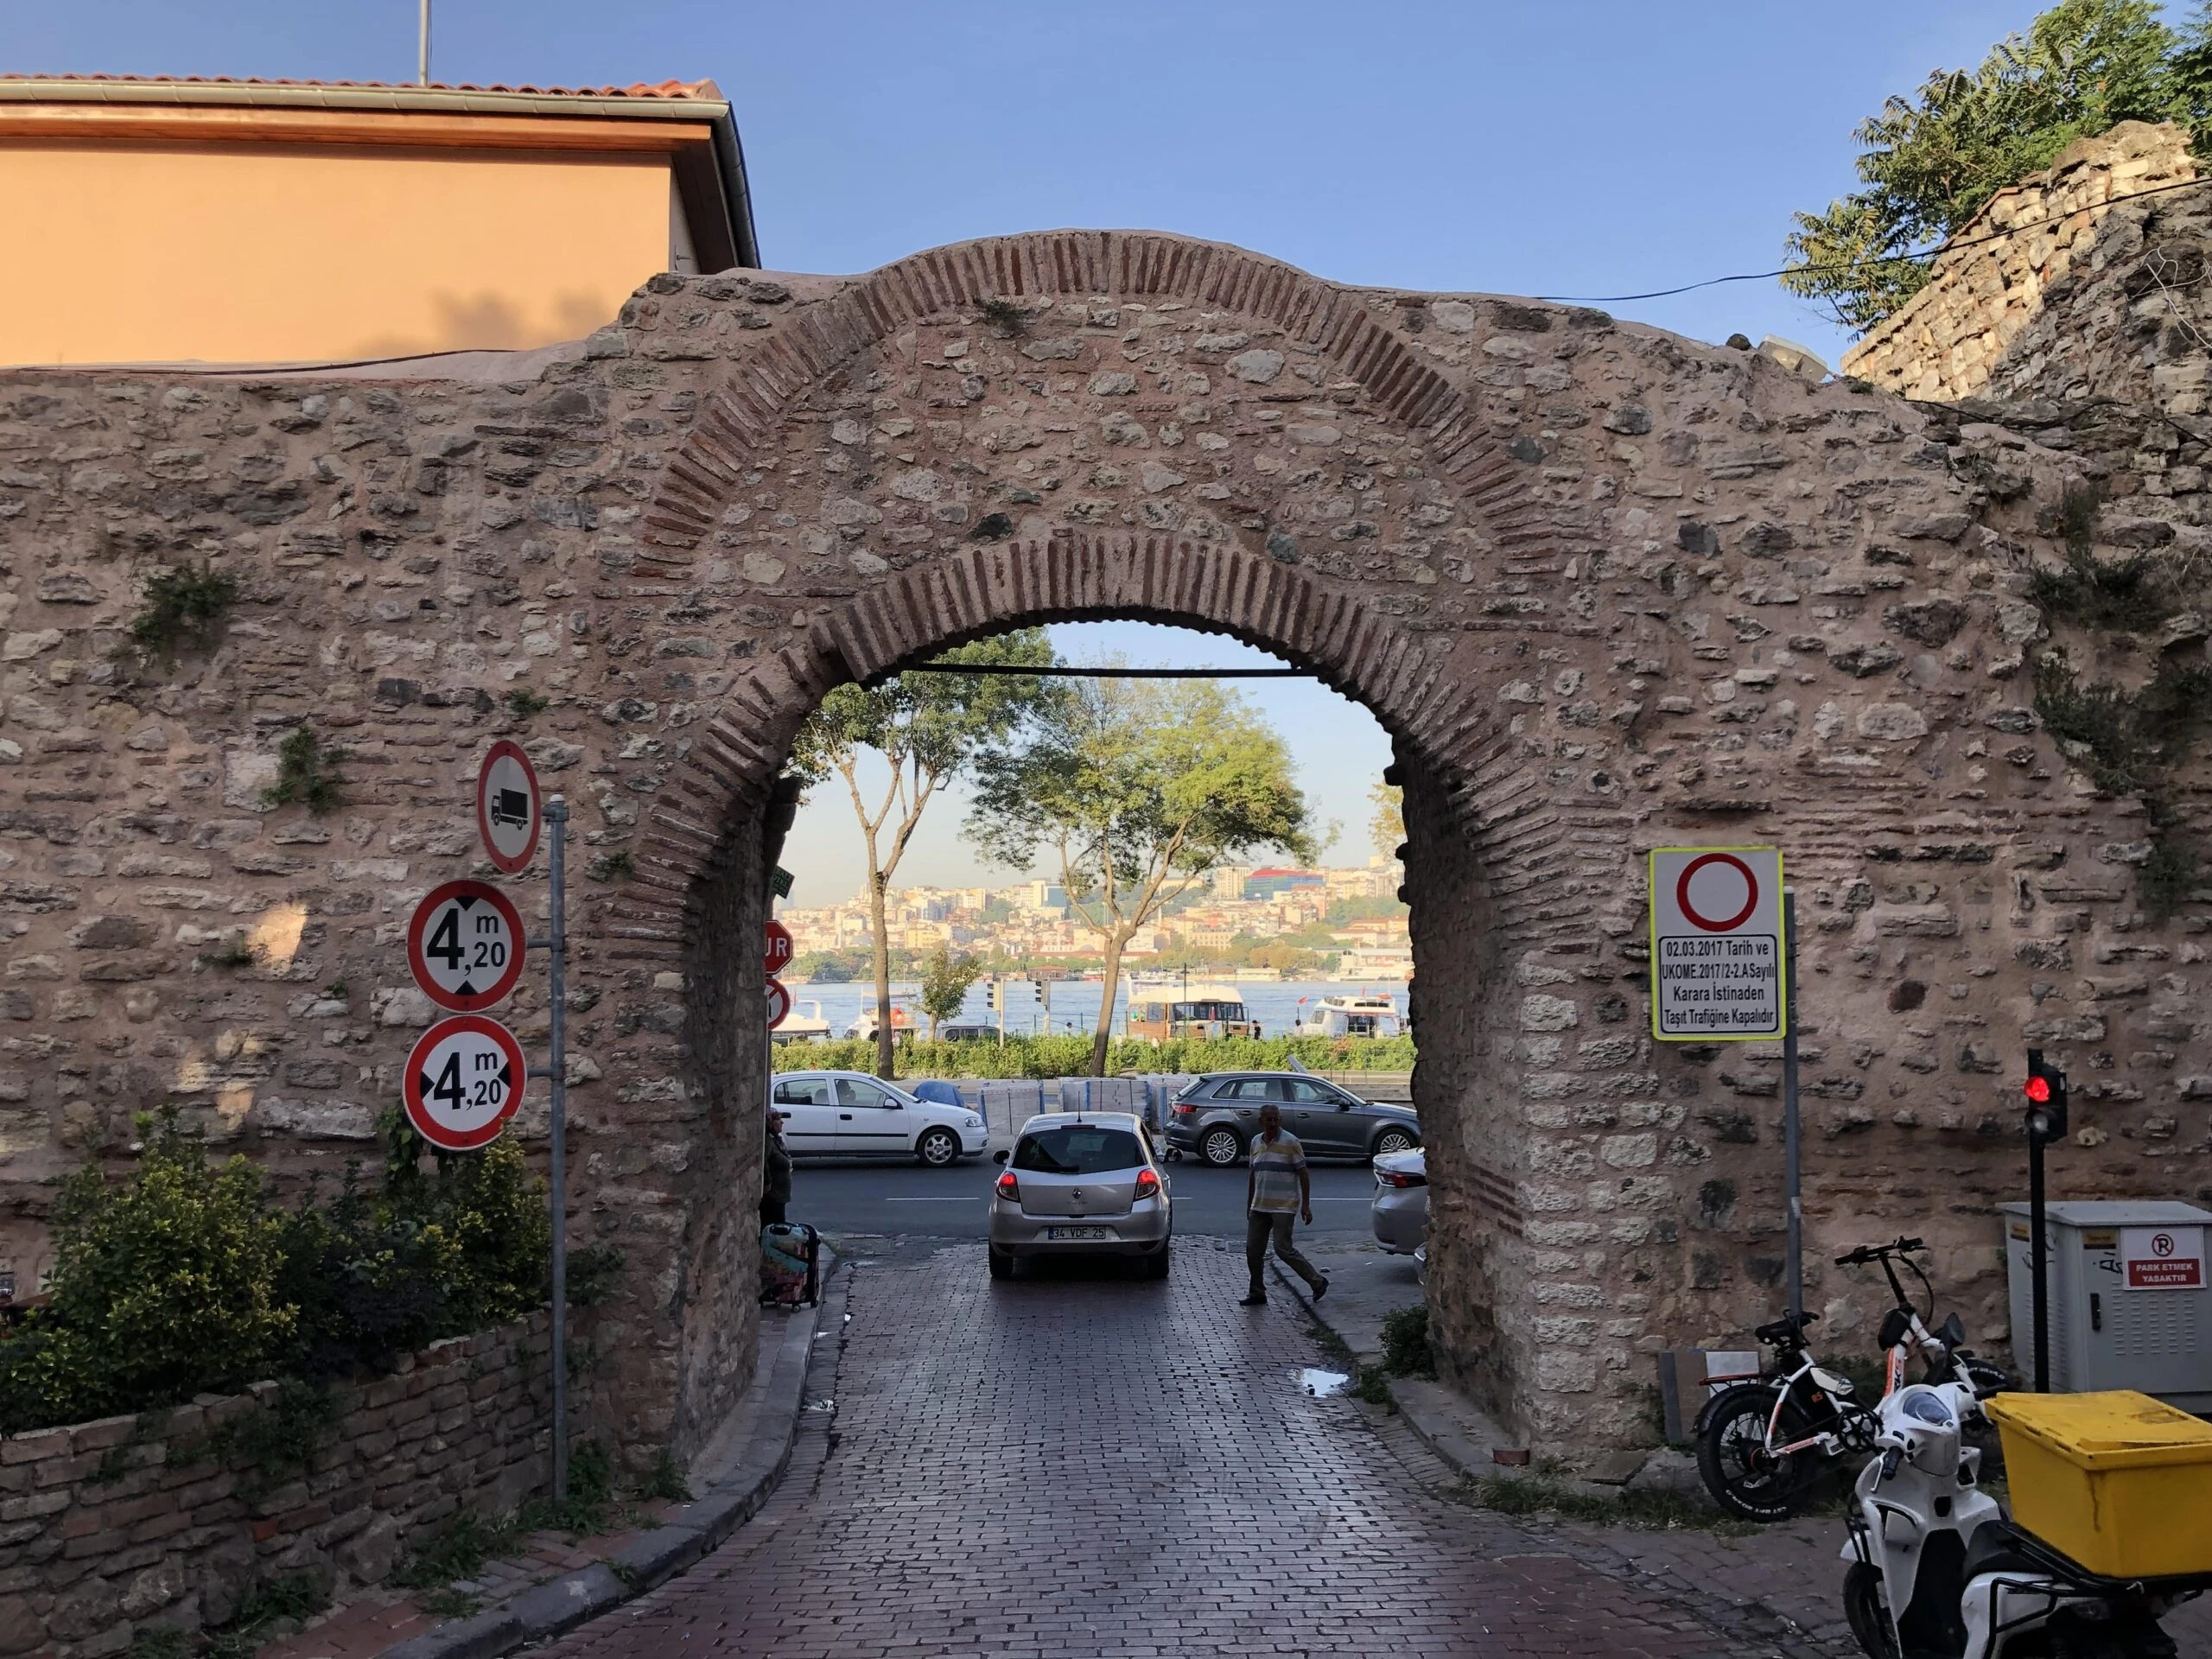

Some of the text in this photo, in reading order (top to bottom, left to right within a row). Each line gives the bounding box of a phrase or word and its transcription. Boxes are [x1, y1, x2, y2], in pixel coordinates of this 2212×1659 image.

[476, 915, 499, 933] m
[427, 908, 505, 976] 4,20
[1666, 940, 1769, 957] 02.03.2017 Tarih ve
[1674, 982, 1764, 1001] Karara İstinaden
[1664, 1007, 1774, 1027] Taşıt Trafiğine Kapalıdır
[475, 1052, 498, 1071] m
[434, 1052, 501, 1110] 4,20
[1054, 1228, 1104, 1238] 34 VDF 25
[2136, 1262, 2194, 1272] PARK ETMEK
[2142, 1274, 2188, 1283] YASAKTIR
